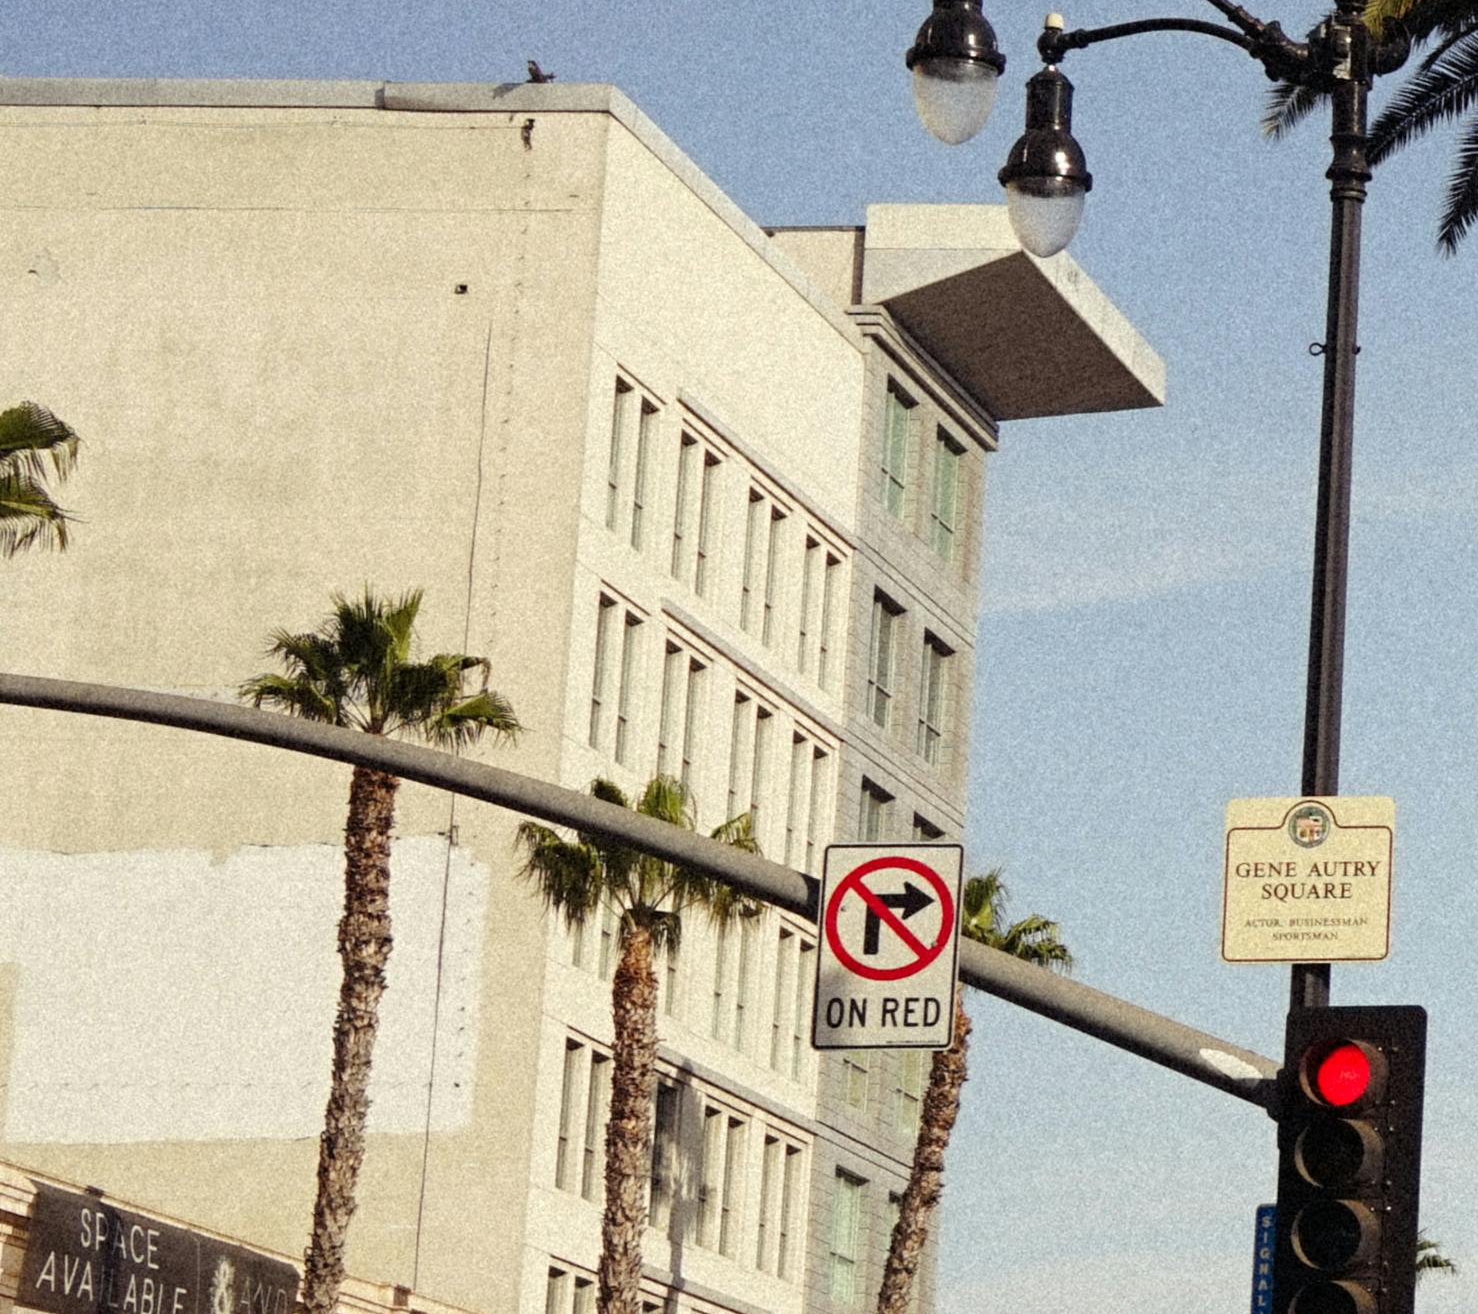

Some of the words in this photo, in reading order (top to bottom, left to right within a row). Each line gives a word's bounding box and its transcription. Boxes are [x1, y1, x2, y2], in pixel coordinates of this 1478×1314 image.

[1236, 861, 1297, 878] GENE
[1308, 860, 1381, 878] AUTRY
[1262, 882, 1353, 902] SQUARE
[1289, 917, 1368, 927] BUSINESSMAN
[1272, 931, 1339, 941] SPORTSMAN
[826, 997, 867, 1028] ON
[881, 997, 941, 1027] RED
[80, 1208, 161, 1270] SPACE
[1258, 1216, 1272, 1307] SIGNAL
